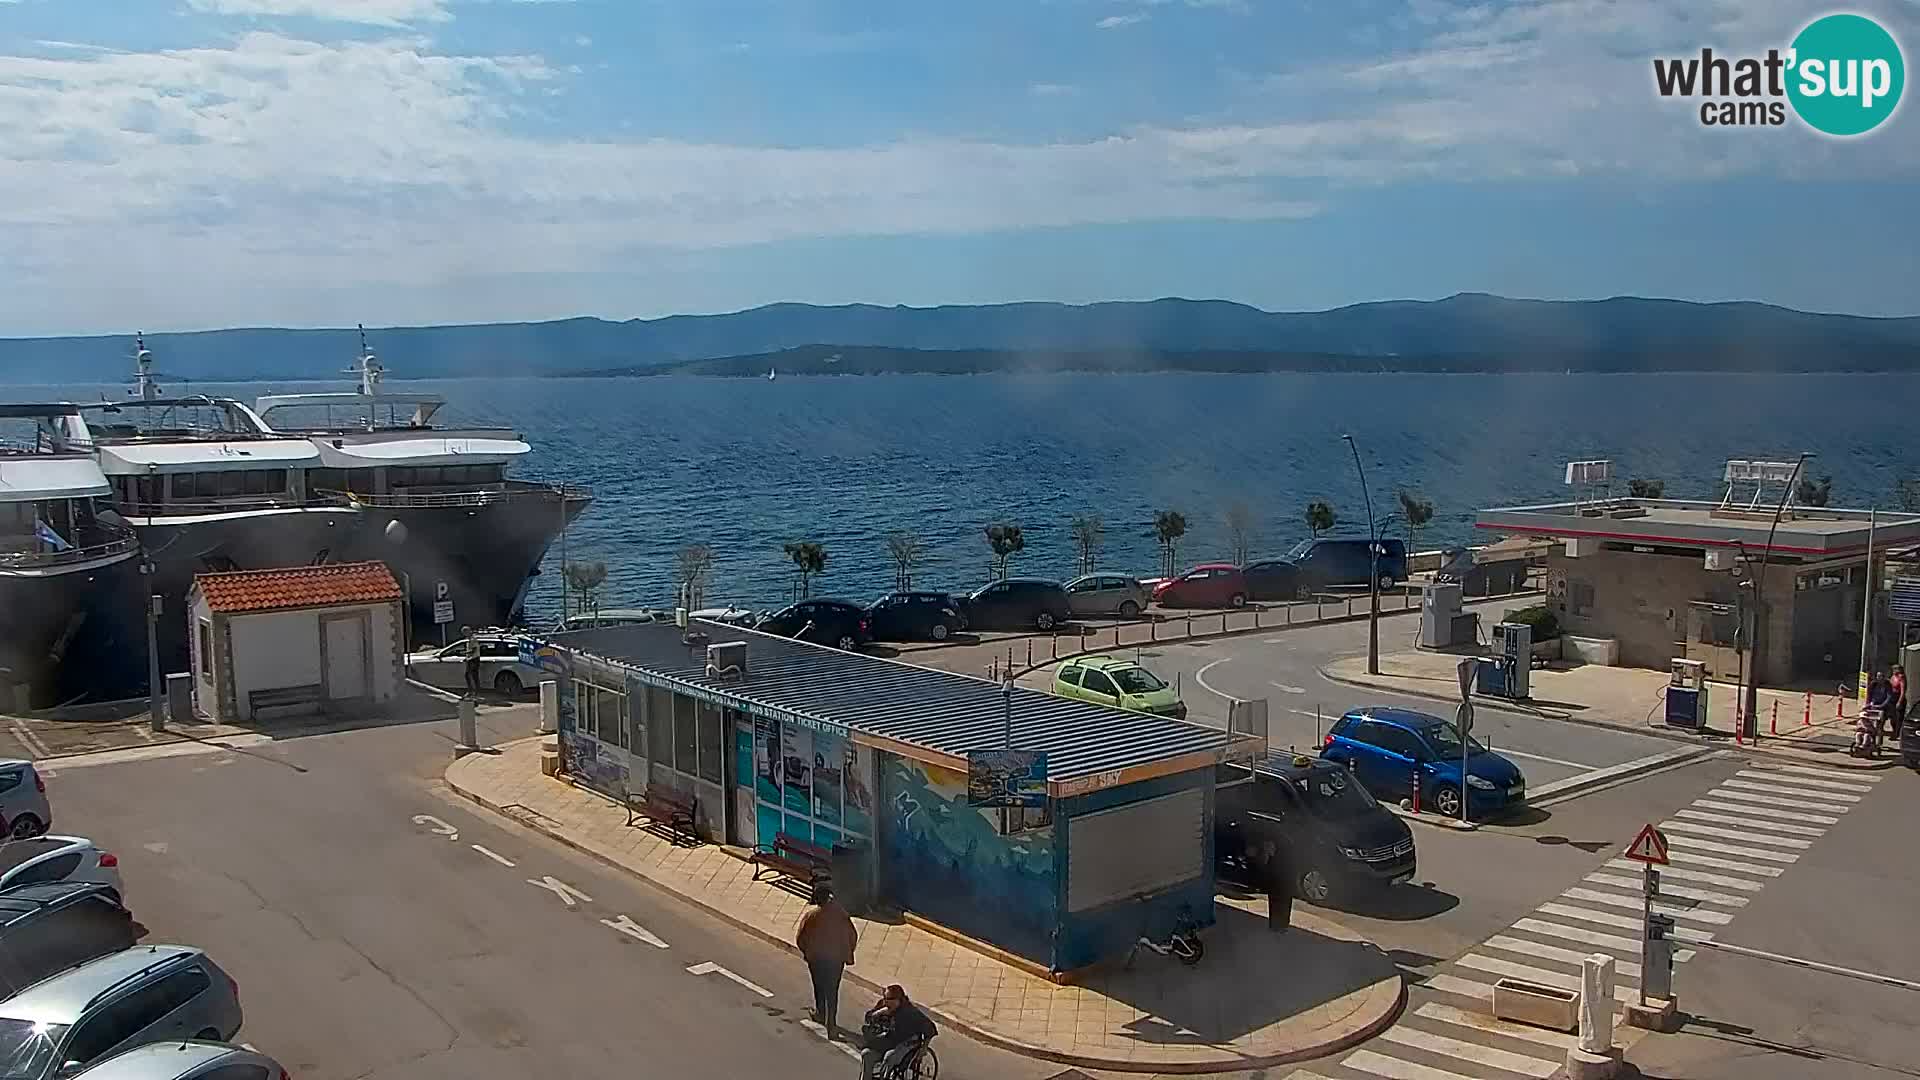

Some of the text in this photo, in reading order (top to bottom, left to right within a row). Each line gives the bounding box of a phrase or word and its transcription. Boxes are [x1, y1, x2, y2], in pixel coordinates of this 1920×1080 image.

[437, 582, 448, 600] P
[711, 690, 740, 708] POSTAJA
[749, 702, 763, 715] BUS
[764, 707, 795, 723] STATION
[797, 716, 820, 731] TICKET
[822, 723, 848, 738] OFFICE
